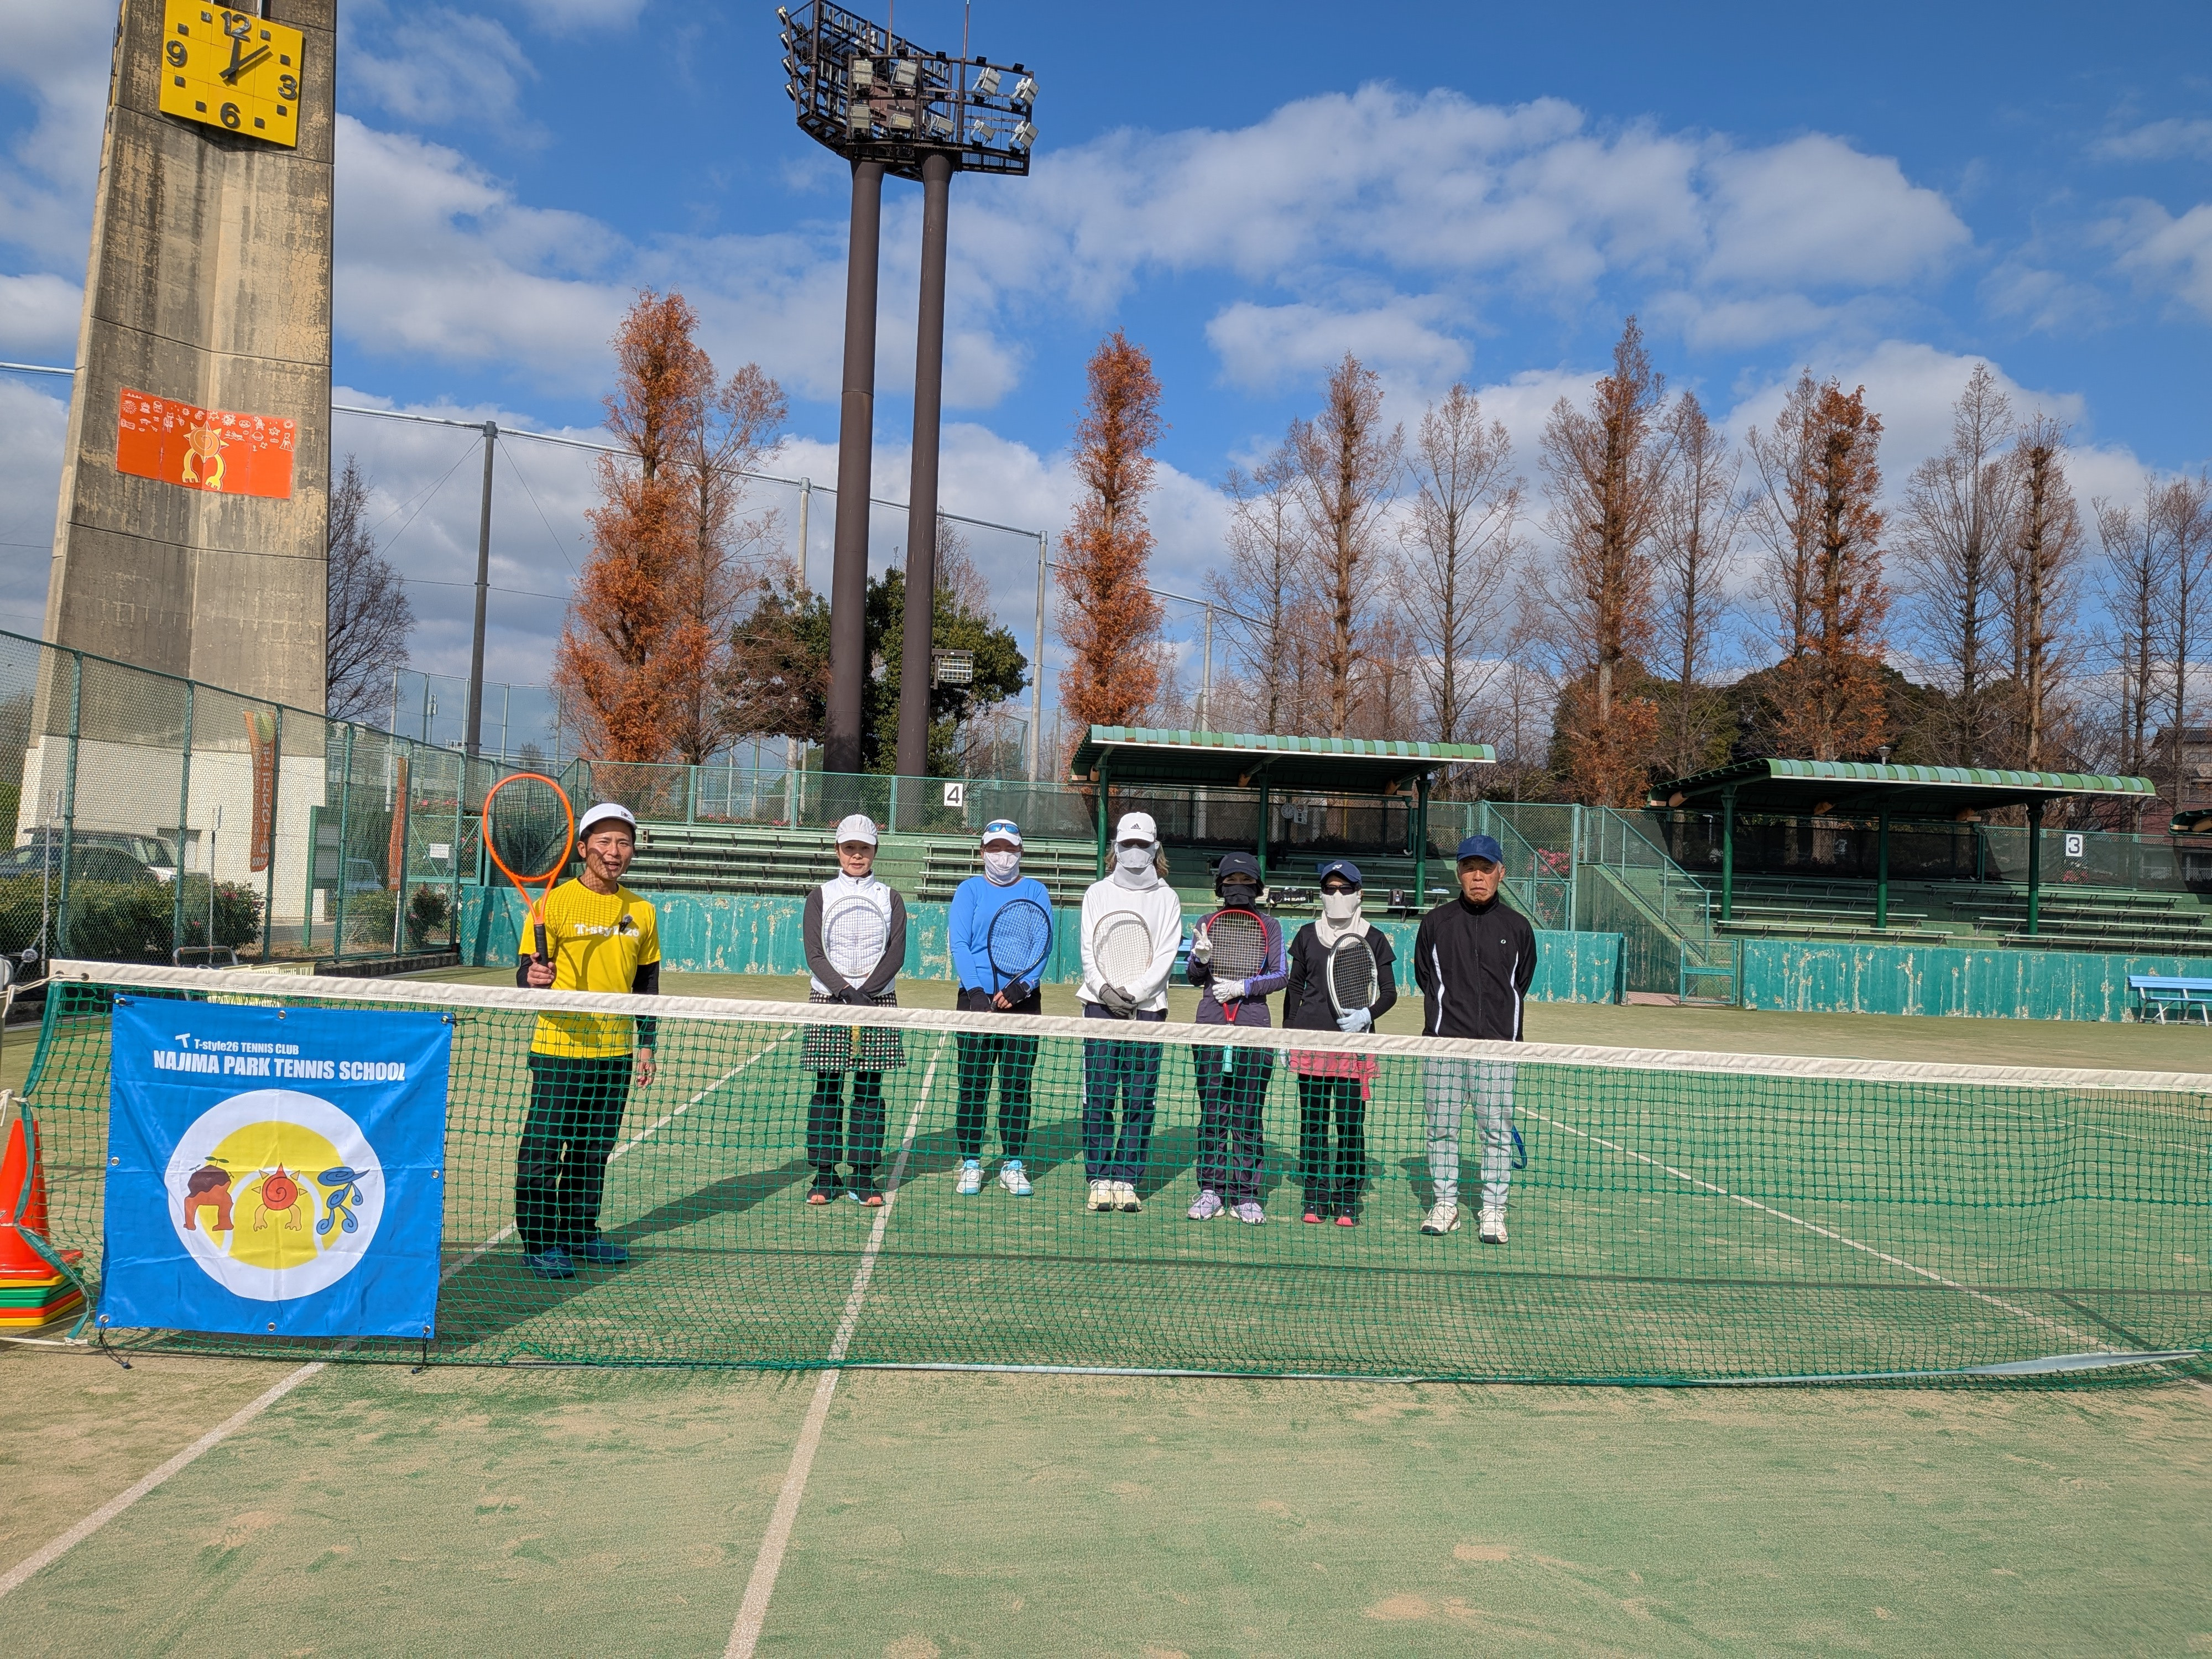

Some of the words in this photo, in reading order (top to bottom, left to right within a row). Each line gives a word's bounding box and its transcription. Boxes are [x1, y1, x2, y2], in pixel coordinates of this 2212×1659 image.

[221, 11, 252, 43] 12
[166, 40, 187, 67] 9
[278, 74, 298, 100] 3
[220, 102, 241, 129] 6
[947, 786, 960, 804] 4
[2068, 837, 2080, 854] 3
[574, 924, 640, 937] T-styl26
[194, 1039, 239, 1052] T-style26
[241, 1042, 274, 1054] TENNIS
[275, 1044, 299, 1055] CLUB
[154, 1050, 220, 1074] NAJIMA
[224, 1056, 270, 1076] PARK
[274, 1058, 335, 1079] TENNIS
[339, 1061, 405, 1081] SCHOOL
